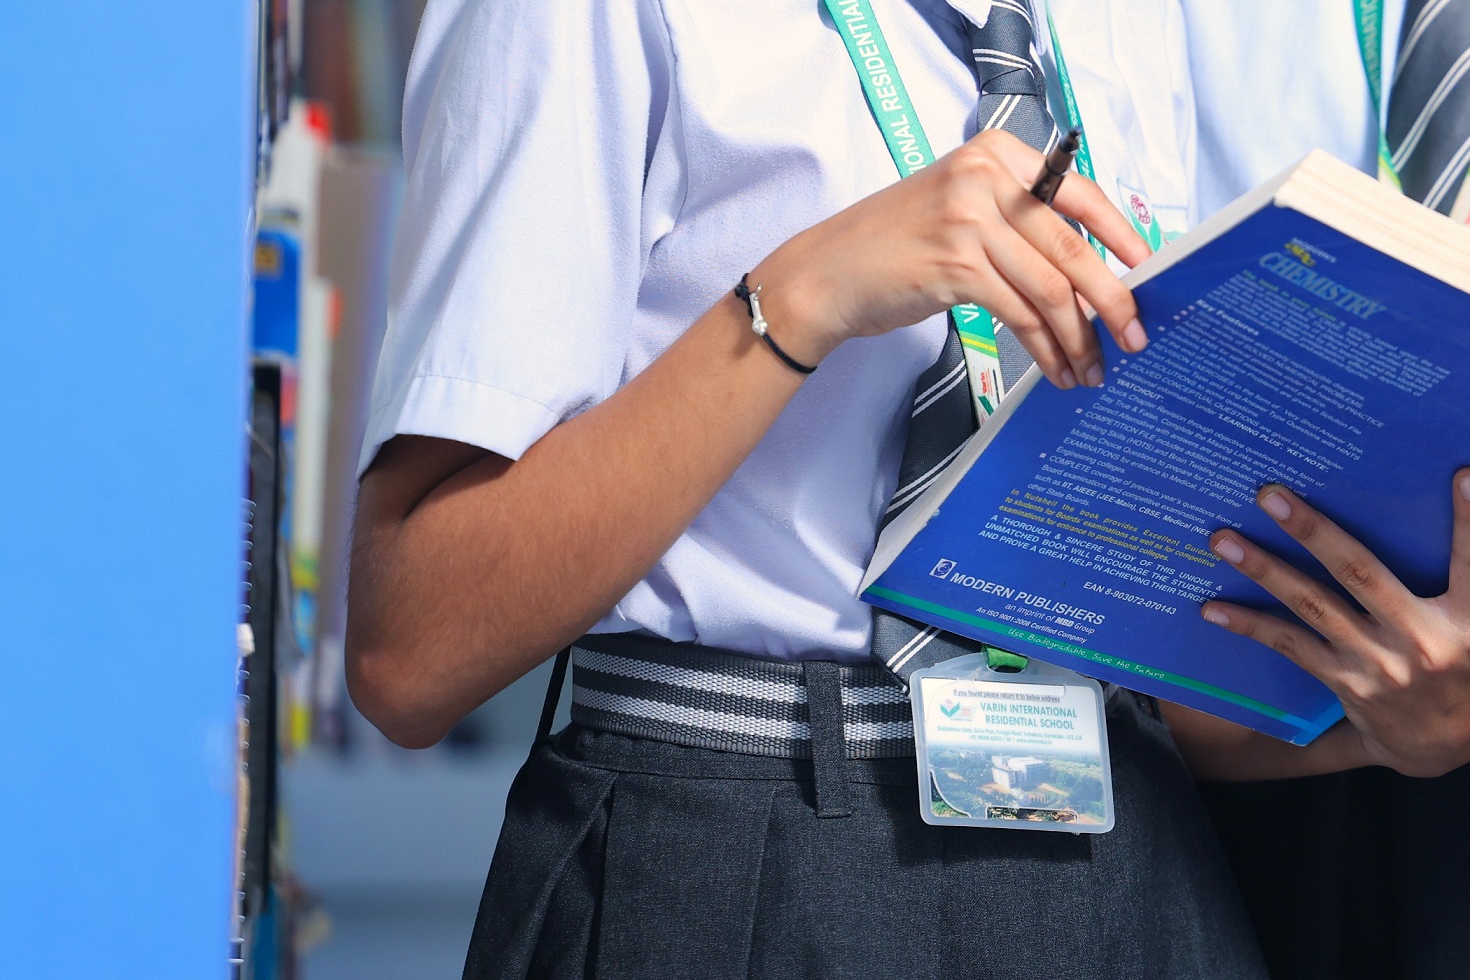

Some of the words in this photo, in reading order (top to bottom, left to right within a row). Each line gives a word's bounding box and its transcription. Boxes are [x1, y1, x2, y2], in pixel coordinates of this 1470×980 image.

[1259, 252, 1387, 320] CHEMISTRY
[1023, 492, 1057, 506] Nutshell
[1061, 503, 1074, 512] the
[1079, 509, 1099, 519] book
[1102, 517, 1138, 531] provides
[1142, 529, 1180, 545] Excellent
[1184, 543, 1224, 560] Guidance
[978, 530, 998, 539] AND
[998, 535, 1029, 549] PROVE
[1038, 547, 1068, 560] GREAT
[1068, 556, 1092, 566] HELP
[1092, 563, 1103, 571] IN
[1102, 567, 1150, 585] ACHIEVING
[1151, 581, 1176, 593] THEIR
[985, 522, 1039, 542] UNMATCHED
[1041, 538, 1068, 551] BOOK
[1070, 547, 1089, 558] WILL
[1094, 554, 1149, 575] ENCOURAGE
[1151, 571, 1169, 582] THE
[1171, 578, 1217, 597] STUDENTS
[1002, 517, 1051, 536] THOROUGH
[1065, 536, 1104, 552] SINCERE
[1106, 548, 1136, 561] STUDY
[1155, 563, 1175, 574] THIS
[1178, 571, 1212, 587] UNIQUE
[950, 572, 1014, 598] MODERN
[1015, 591, 1104, 624] PUBLISHERS
[1083, 581, 1104, 592] EAN
[985, 609, 999, 617] ISO
[1030, 622, 1058, 634] Certified
[1057, 630, 1087, 643] Company
[1016, 606, 1045, 618] imprint
[1054, 616, 1074, 627] MBD
[1073, 622, 1095, 634] Group
[1007, 628, 1024, 637] Use
[1091, 652, 1112, 663] Save
[1115, 660, 1130, 668] the
[1133, 664, 1164, 678] Future
[980, 702, 1007, 712] VARIN
[1009, 704, 1077, 718] INTERNATIONAL
[983, 691, 999, 699] please
[1041, 695, 1061, 703] address
[985, 714, 1038, 727] RESIDENTIAL
[1040, 718, 1074, 730] SCHOOL
